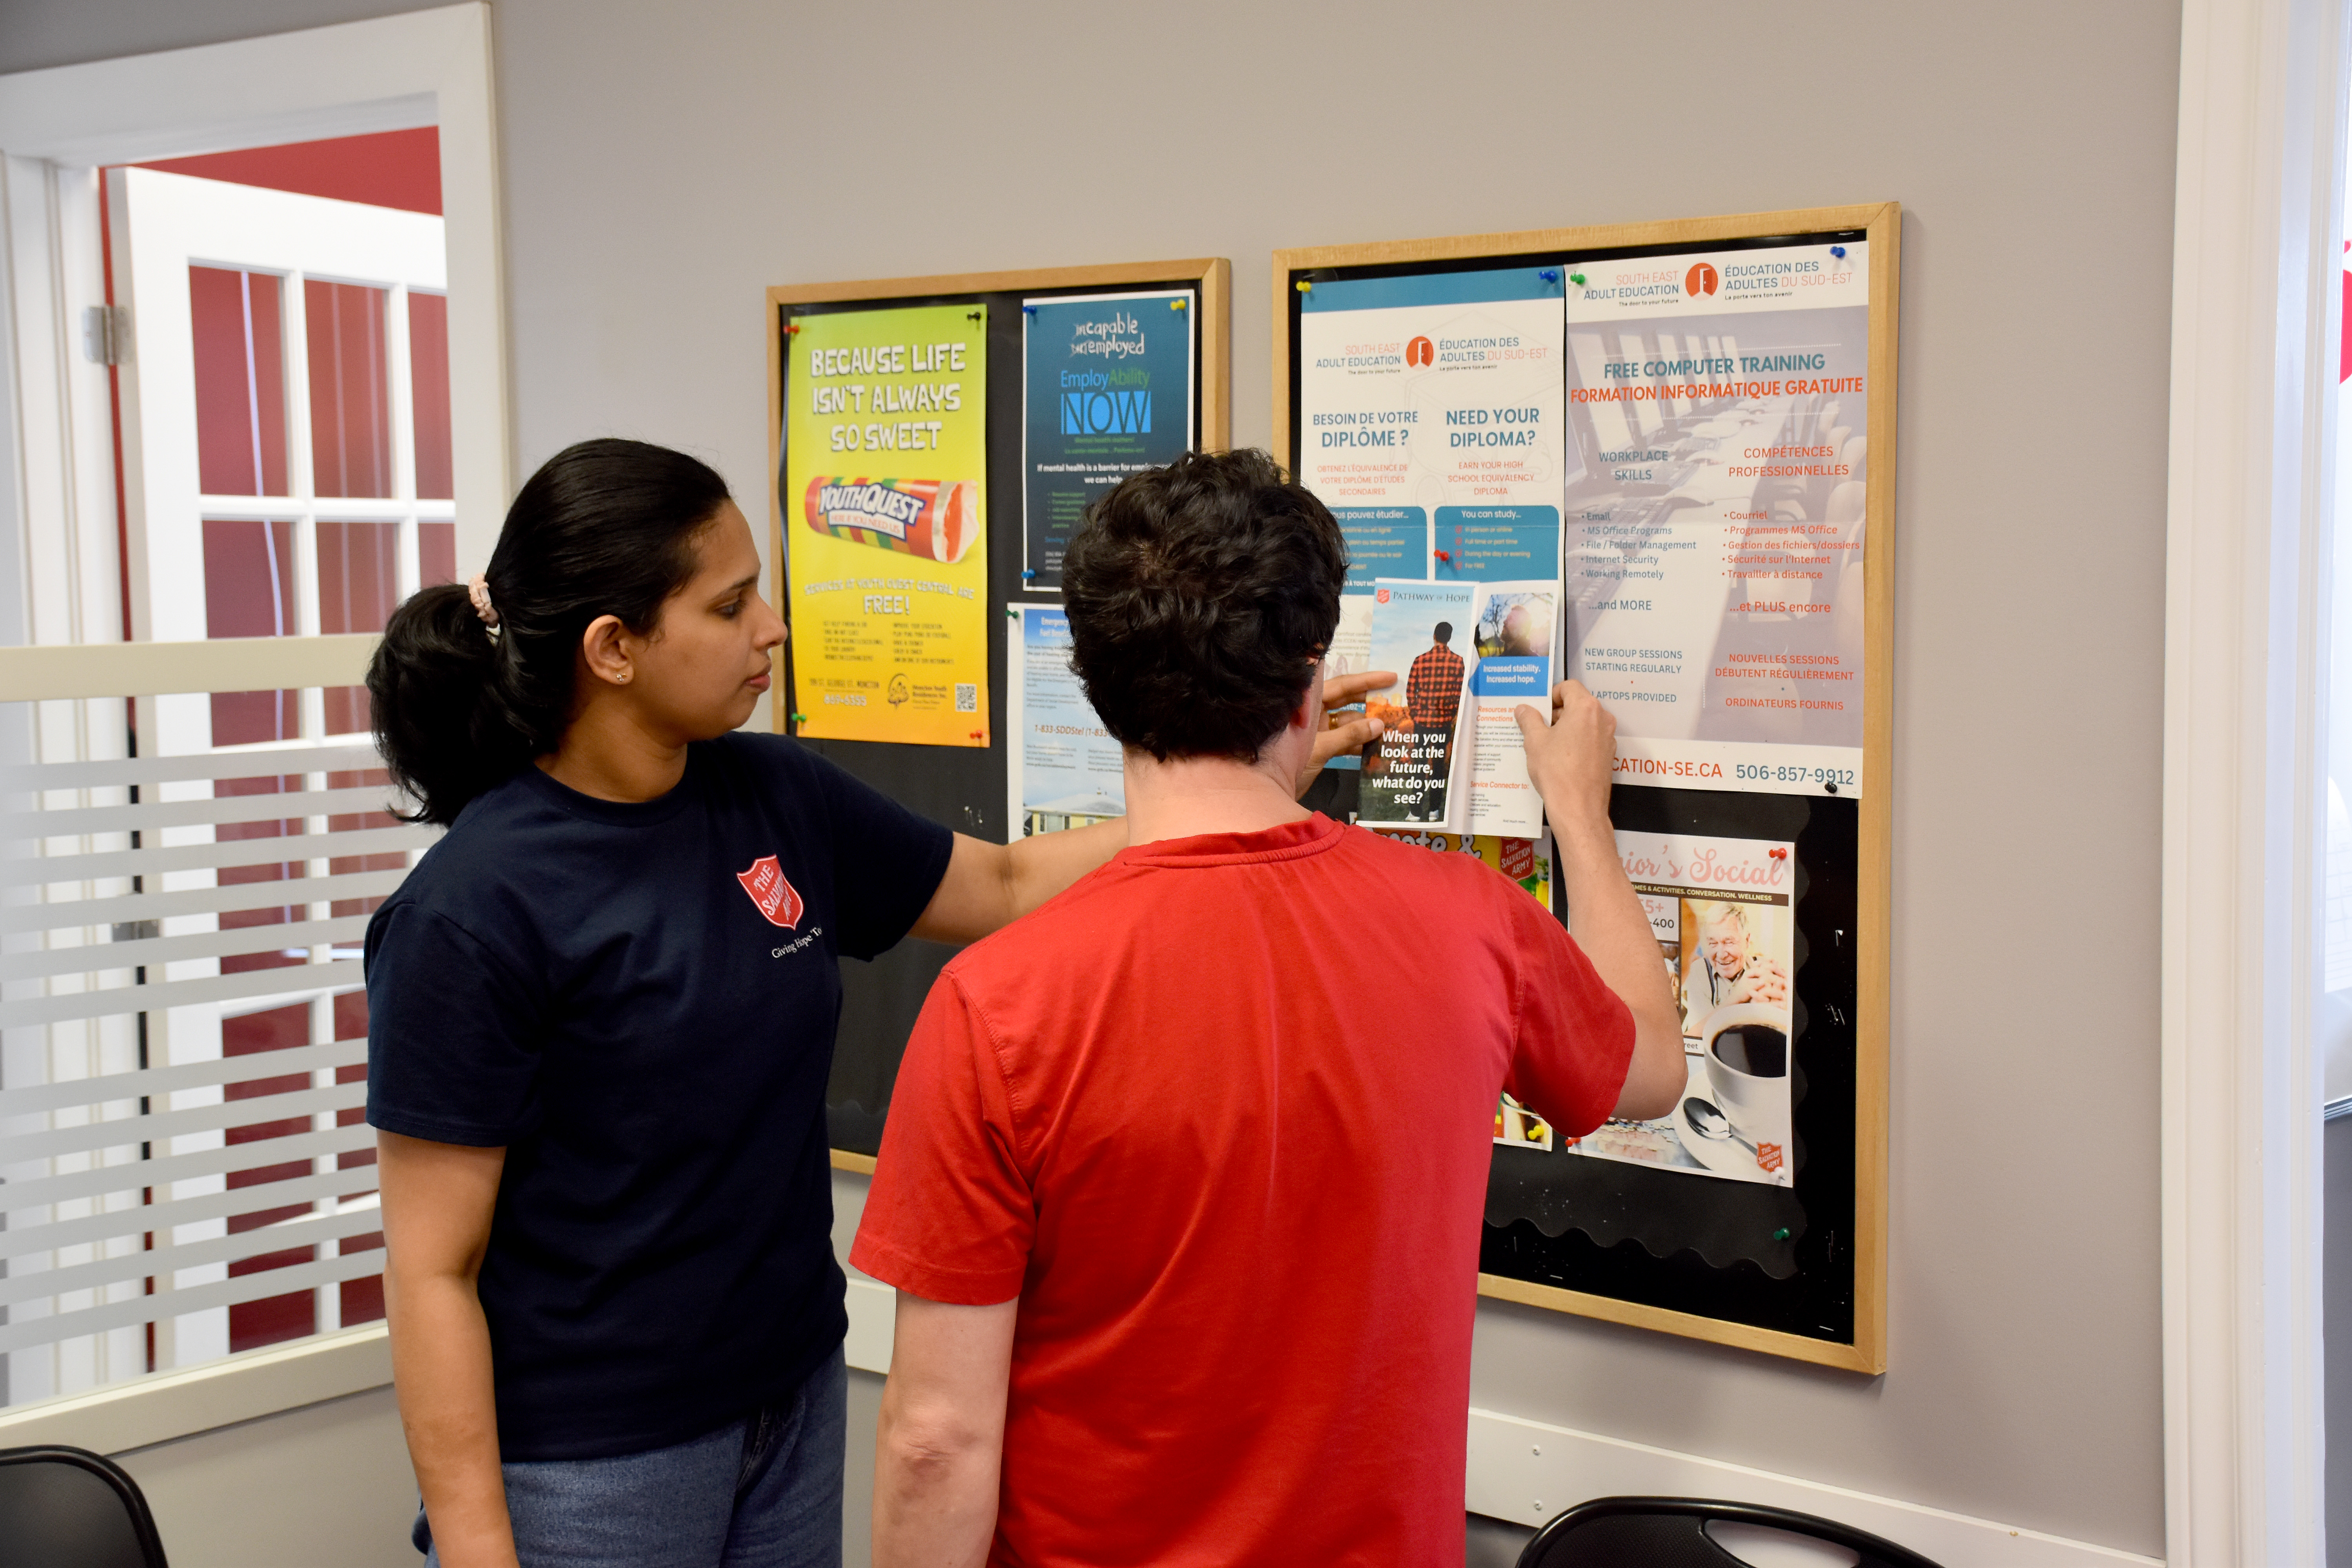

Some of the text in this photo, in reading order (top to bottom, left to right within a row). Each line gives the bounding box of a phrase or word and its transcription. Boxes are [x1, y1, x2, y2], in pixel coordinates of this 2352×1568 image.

[1725, 261, 1819, 277] ÉDUCATION DES
[1616, 270, 1679, 285] SOUTH EAST
[1726, 272, 1852, 290] ADULTES DU SUD-EST
[1584, 285, 1679, 300] ADULT EDUCATION
[1345, 343, 1400, 355] SOUTH EAST
[1439, 337, 1519, 350] ÉDUCATION DES
[811, 343, 966, 377] BECAUSE LIFE
[1440, 348, 1548, 362] ADULTES DU SUD-EST
[1316, 356, 1401, 368] ADULT EDUCATION
[1604, 353, 1825, 379] FREE COMPUTER TRAINING
[1571, 377, 1863, 403] FORMATION INFORMATIQUE GRATUITE
[813, 383, 961, 414] ISN'T ALWAYS
[1061, 391, 1151, 435] NOW
[1313, 411, 1418, 425] BESOIN DE VOTRE
[1446, 408, 1539, 425] NEED YOUR
[831, 421, 942, 452] SO SWEET
[1322, 426, 1396, 448] DIPLÔME
[1450, 430, 1536, 448] DIPLOMA?
[1599, 450, 1668, 462] WORKPLACE
[1744, 445, 1833, 458] COMPÉTENCES
[1459, 461, 1523, 470] EARN YOUR HIGH
[1729, 465, 1849, 477] PROFESSIONNELLES
[1343, 475, 1372, 484] DIPLÔME
[1448, 473, 1534, 483] SCHOOL EQUIVALENCY
[1615, 470, 1652, 481] SKILLS
[1474, 487, 1508, 495] DIPLOMA
[1347, 512, 1374, 521] pouvez
[1587, 512, 1611, 521] Email
[1730, 511, 1768, 520] Courriel
[1587, 526, 1672, 536] MS Office Programs
[1730, 525, 1837, 536] Programmes MS Office
[1586, 541, 1697, 551] File Folder Management
[1728, 541, 1860, 551] Gestion des fichiers/dossiers
[1586, 555, 1659, 566] Internet Security
[1728, 555, 1766, 564] Sécurité
[1786, 555, 1831, 564] l'Internet
[1586, 569, 1664, 581] Working Remotely
[1727, 570, 1823, 579] Travailler distance
[1393, 592, 1433, 602] PATHWAY
[1446, 593, 1470, 603] HOPE
[864, 594, 910, 615] FREE!
[1589, 600, 1652, 610] ...and MORE
[1730, 602, 1831, 613] ...et PLUS encore
[1585, 648, 1682, 659] NEW GROUP SESSIONS
[1729, 654, 1839, 665] NOUVELLES SESSIONS
[1483, 664, 1541, 674] Increased stability.
[1586, 662, 1681, 674] STARTING REGULARLY
[1715, 667, 1854, 681] DÉBUTENT RÉGULIÈREMENT
[1486, 675, 1536, 684] Increased hope.
[1632, 692, 1677, 702] PROVIDED
[1726, 698, 1844, 710] ORDINATEURS FOURNIS
[1383, 730, 1446, 745] When you
[1380, 744, 1444, 759] look at the
[1390, 760, 1433, 775] future,
[1736, 764, 1854, 786] 506-857-9912
[1372, 777, 1445, 791] what do you
[1394, 792, 1423, 805] see?
[1506, 840, 1519, 854] THE
[1501, 845, 1531, 869] SALVATION
[1512, 857, 1530, 875] ARMY
[1689, 848, 1783, 886] Social
[753, 864, 774, 892] THE
[1737, 892, 1772, 902] WELLNESS
[771, 926, 822, 958] Giving Hope To
